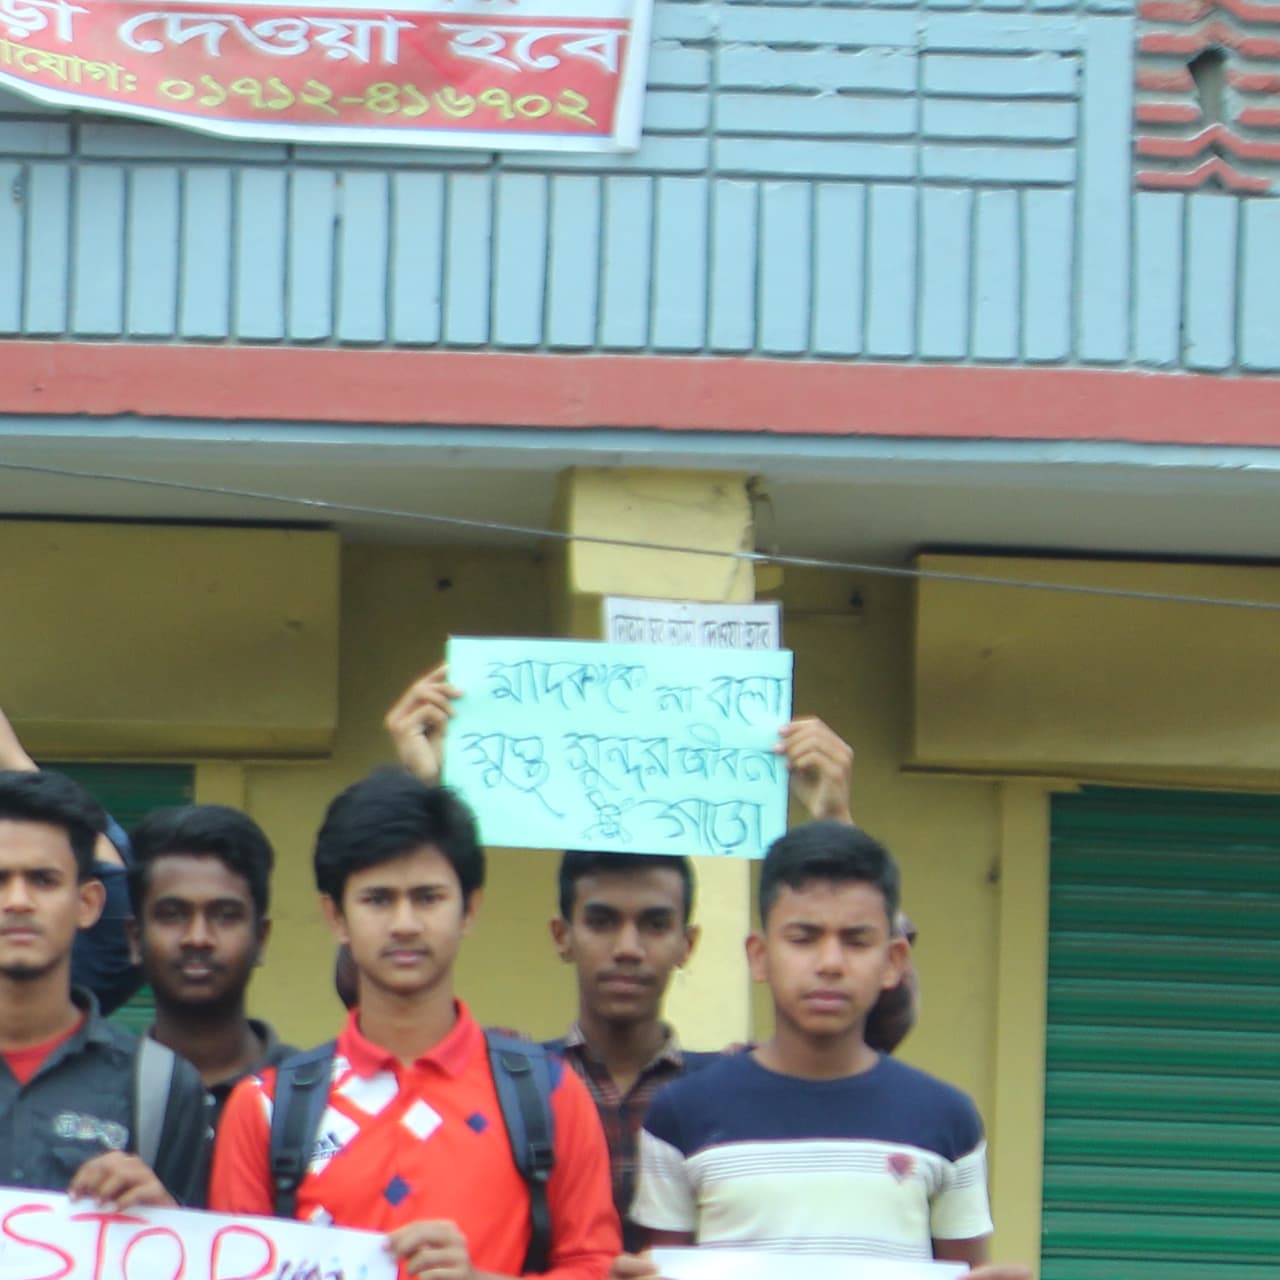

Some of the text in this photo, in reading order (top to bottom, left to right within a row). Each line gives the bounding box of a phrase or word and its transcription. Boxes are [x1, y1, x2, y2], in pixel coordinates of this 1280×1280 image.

[116, 11, 417, 65] দেওয়া
[438, 22, 633, 73] হবে
[158, 75, 598, 127] ০১৭১২-৪১৬৭০২
